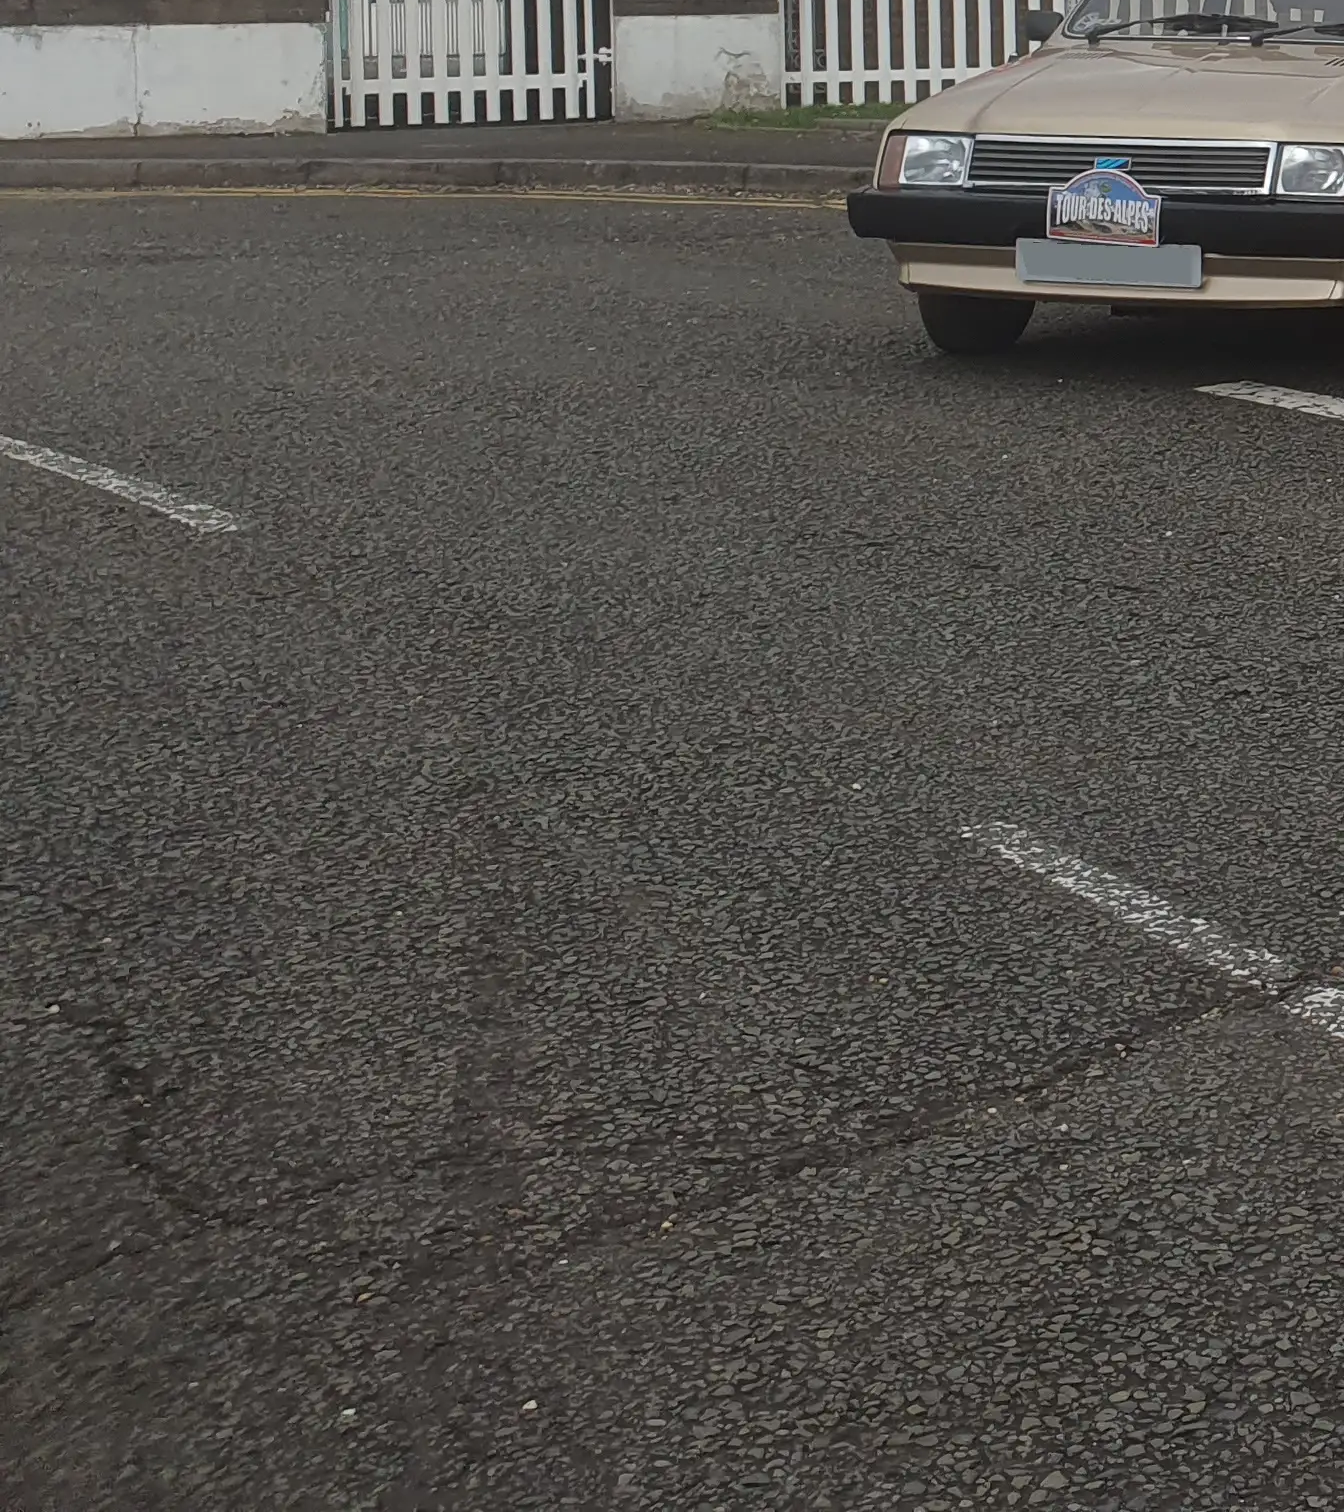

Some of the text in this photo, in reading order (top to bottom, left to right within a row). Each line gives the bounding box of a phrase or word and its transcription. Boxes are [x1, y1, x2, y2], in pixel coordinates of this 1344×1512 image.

[1056, 193, 1150, 234] TOUR DES ALPES
